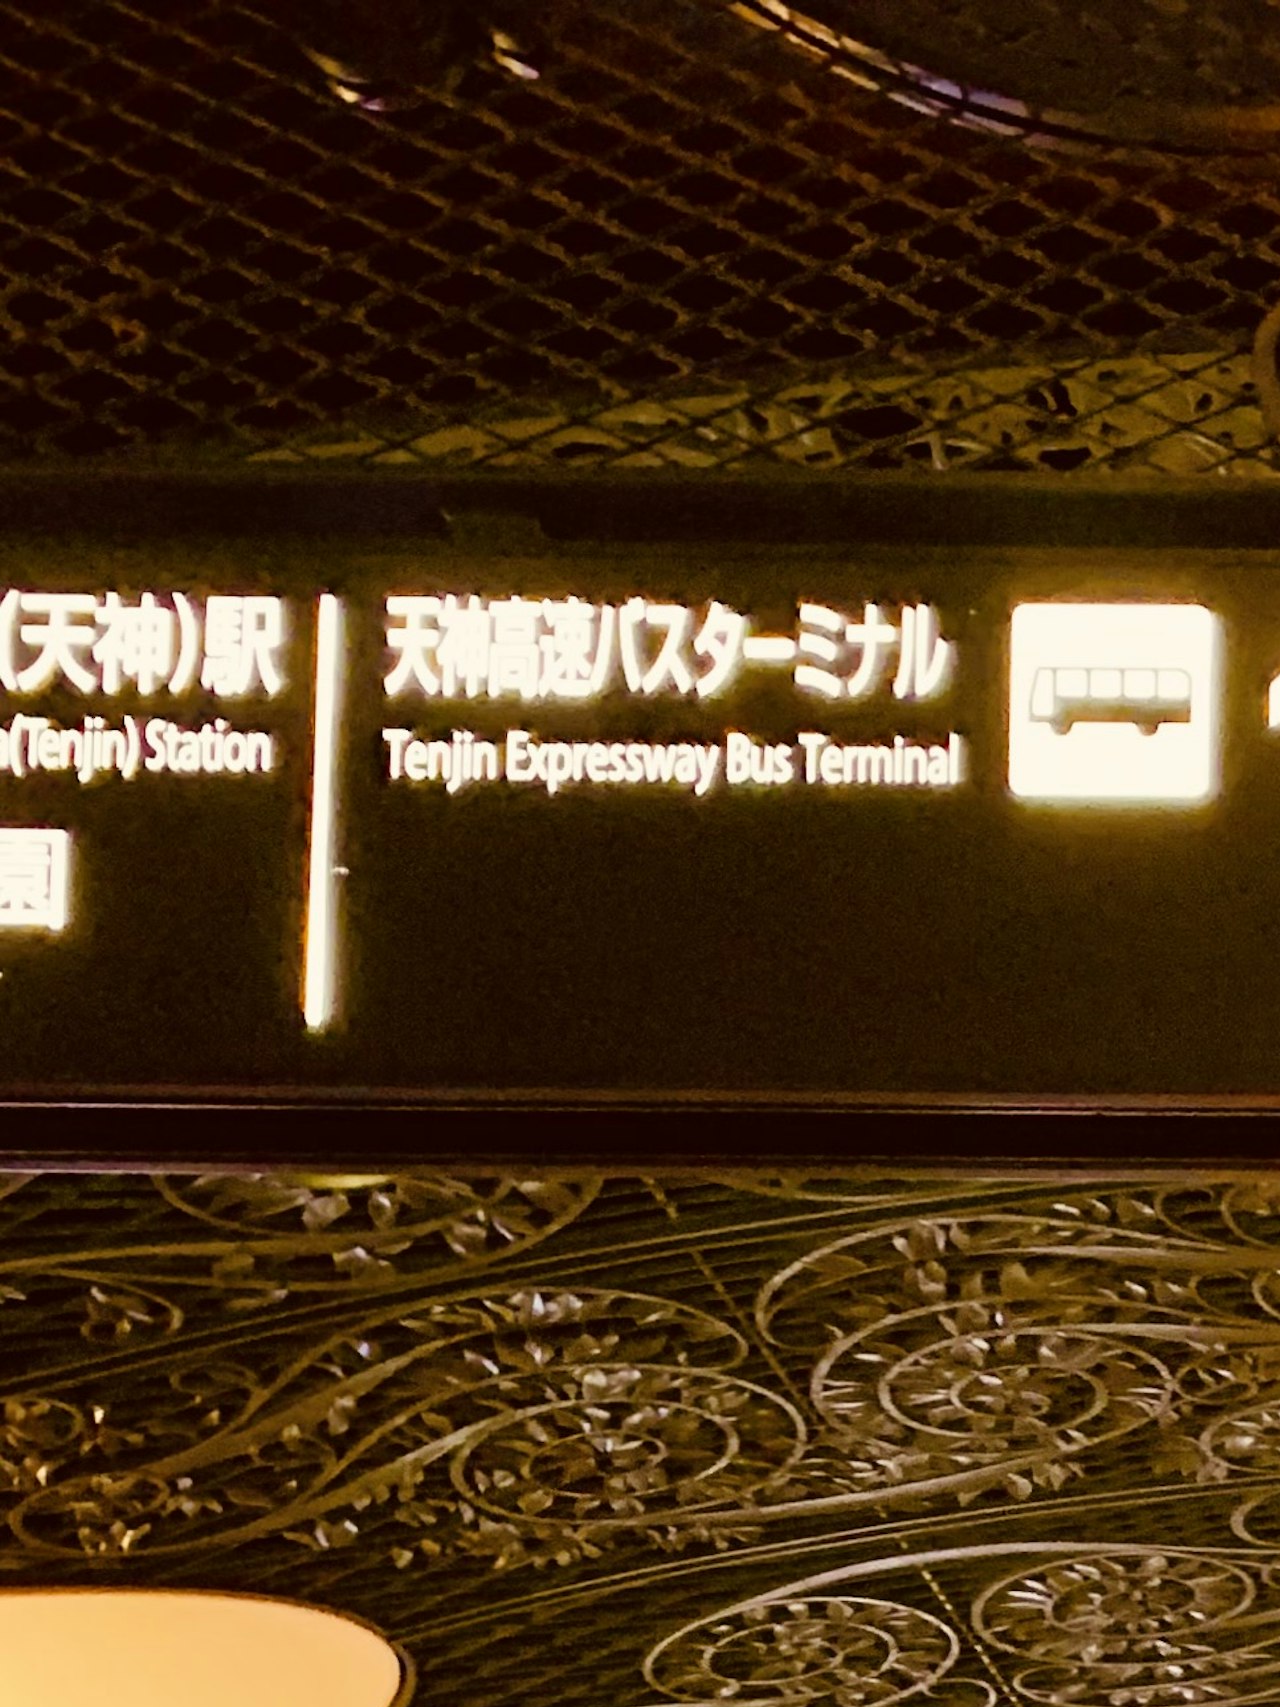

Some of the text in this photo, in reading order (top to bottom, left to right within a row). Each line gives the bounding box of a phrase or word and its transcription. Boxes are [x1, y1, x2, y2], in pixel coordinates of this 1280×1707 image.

[383, 595, 955, 699] 天神高速バスターミナル
[145, 718, 273, 773] Station
[383, 729, 961, 796] Tenjin Expressway Bus Terminal
